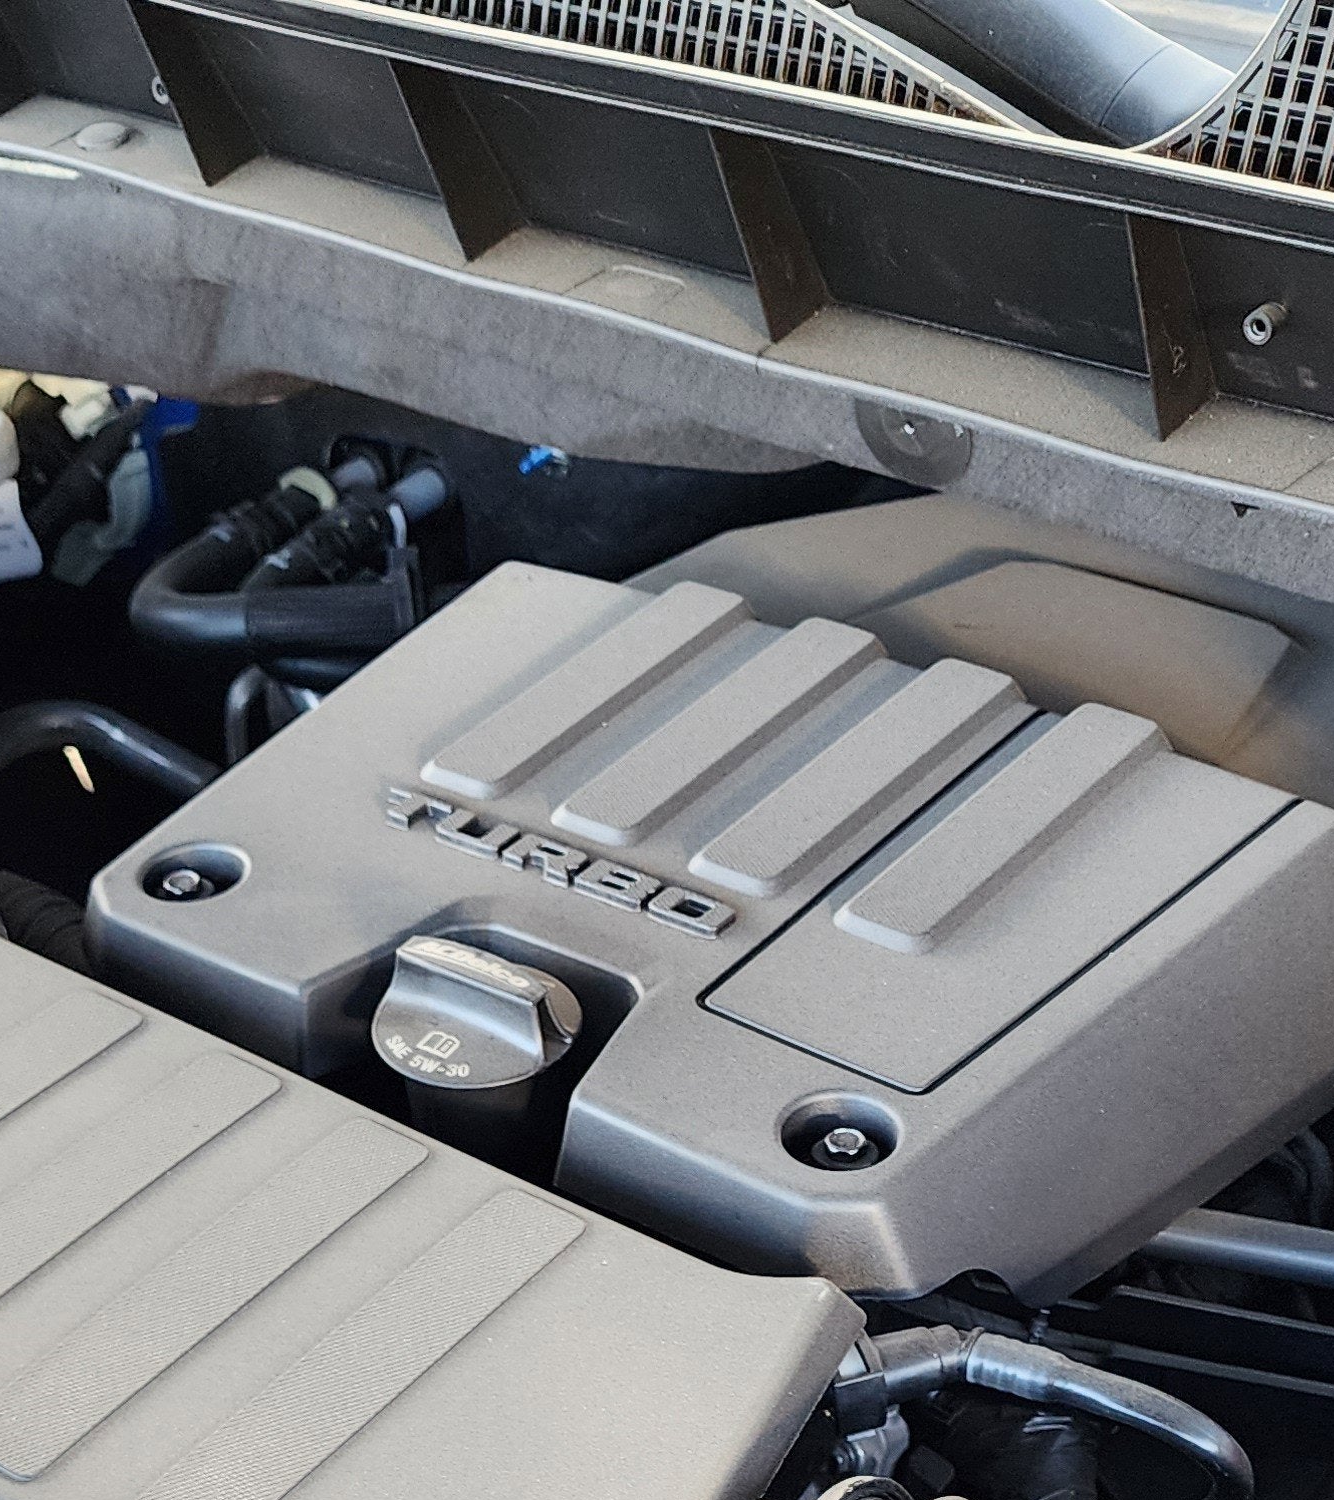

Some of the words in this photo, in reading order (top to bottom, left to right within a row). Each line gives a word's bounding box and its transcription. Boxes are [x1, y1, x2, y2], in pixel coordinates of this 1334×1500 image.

[384, 785, 738, 941] TURBO
[385, 1034, 413, 1061] SAE
[408, 1054, 470, 1077] 5W-30
